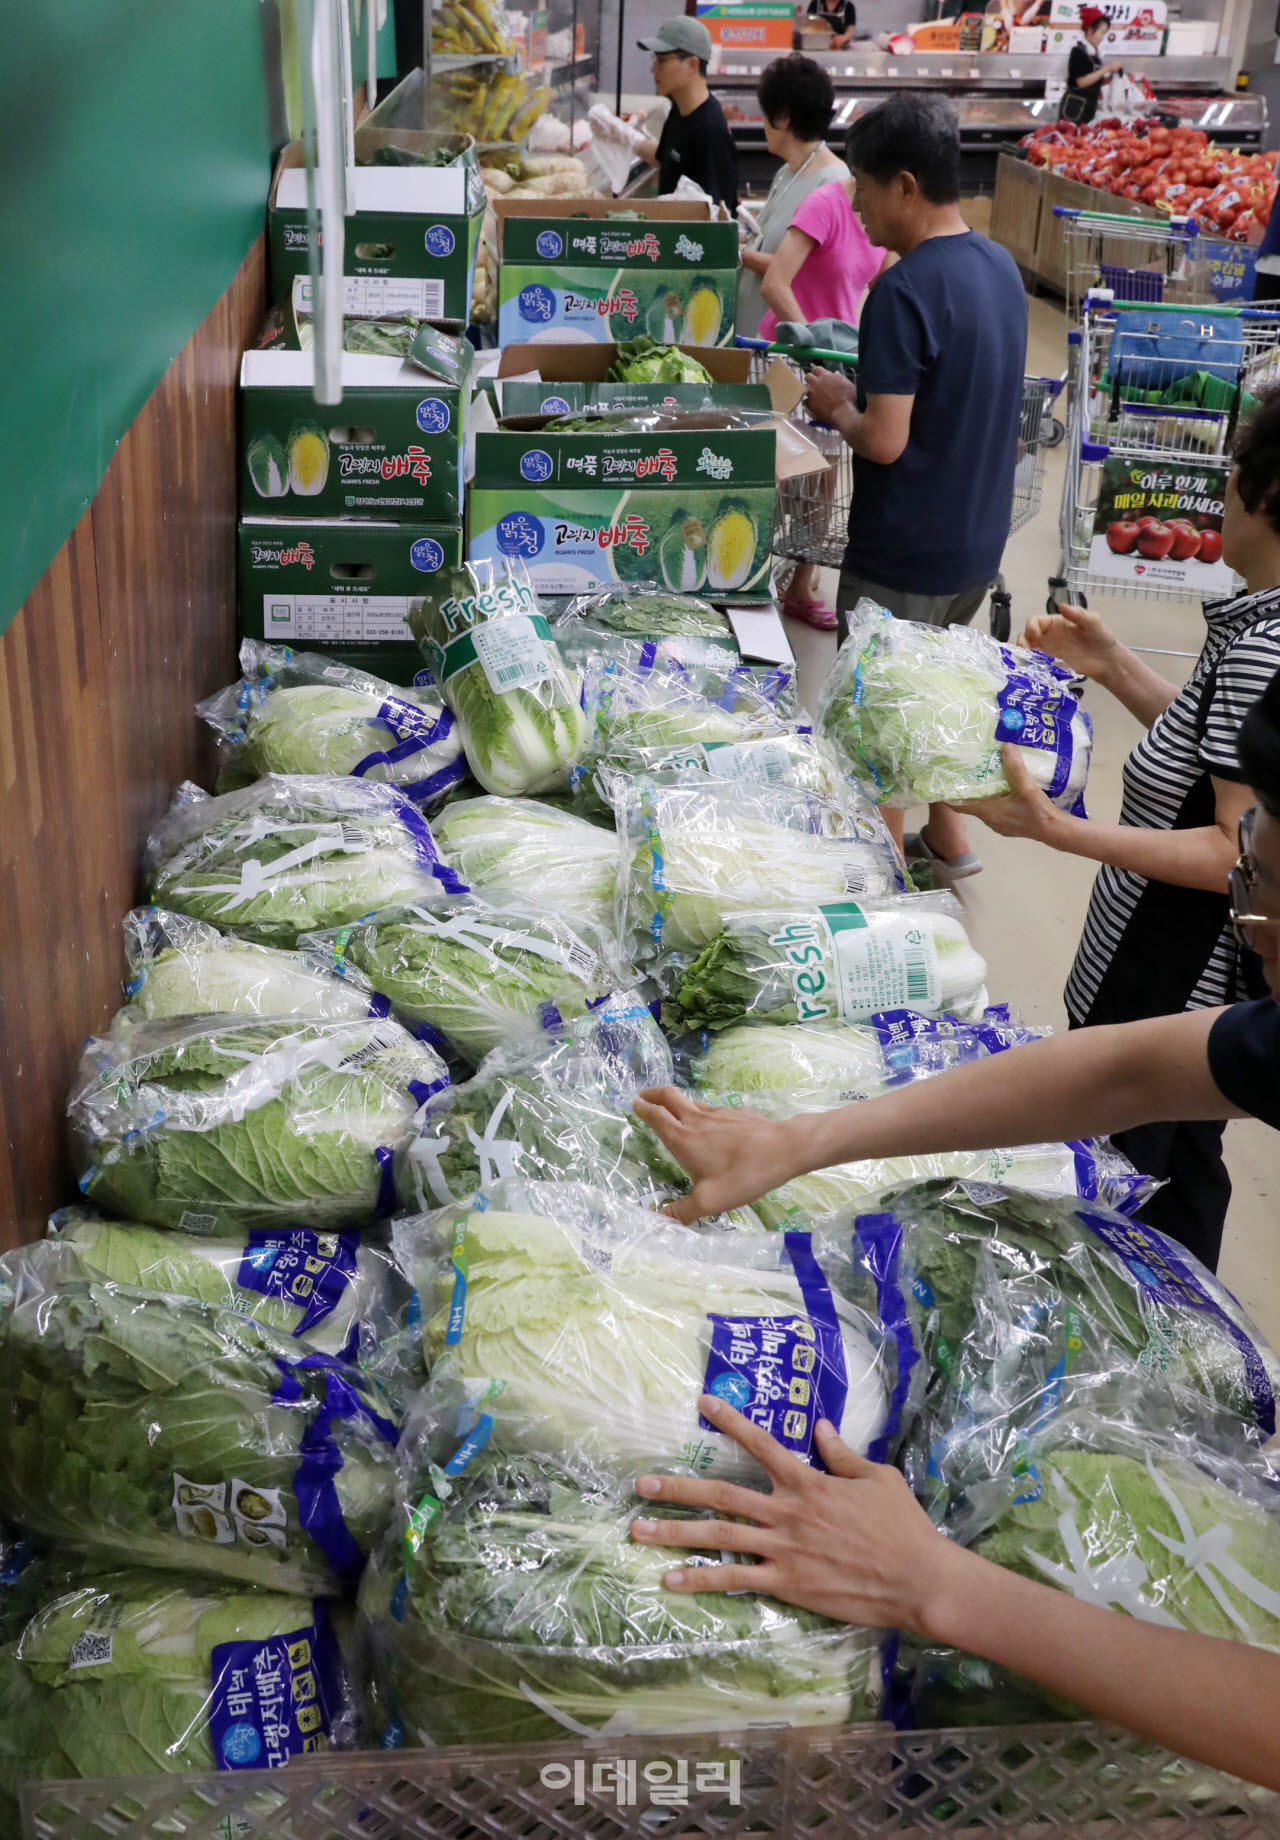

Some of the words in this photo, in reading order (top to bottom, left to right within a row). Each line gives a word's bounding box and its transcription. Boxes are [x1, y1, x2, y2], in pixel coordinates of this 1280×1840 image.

[573, 237, 597, 254] 명품
[600, 233, 660, 262] 고랭지배추
[521, 288, 551, 320] 맑은청
[564, 289, 638, 323] 고랭지배추
[420, 403, 445, 429] 맑은청
[338, 446, 432, 486] 고랭지배추
[523, 454, 548, 478] 맑은청
[567, 455, 598, 475] 명품
[602, 448, 678, 481] 고랭지배추
[1141, 474, 1172, 490] 하루
[1175, 475, 1208, 494] 한개,
[1114, 493, 1145, 509] 매일
[501, 517, 539, 554] 맑은청
[554, 515, 650, 556] 고랭지배추
[250, 542, 315, 570] 고랭지배추
[414, 543, 438, 568] 맑은청
[439, 576, 534, 632] Fresh
[241, 690, 248, 702] NH
[768, 921, 830, 1021] resh
[450, 1306, 463, 1333] NH
[724, 1322, 755, 1364] 태백
[751, 1317, 786, 1432] 고랭지배추
[454, 1442, 478, 1466] NH
[226, 1668, 253, 1716] 태백
[253, 1646, 290, 1768] 고랭지배추
[226, 1727, 255, 1760] 맑은청
